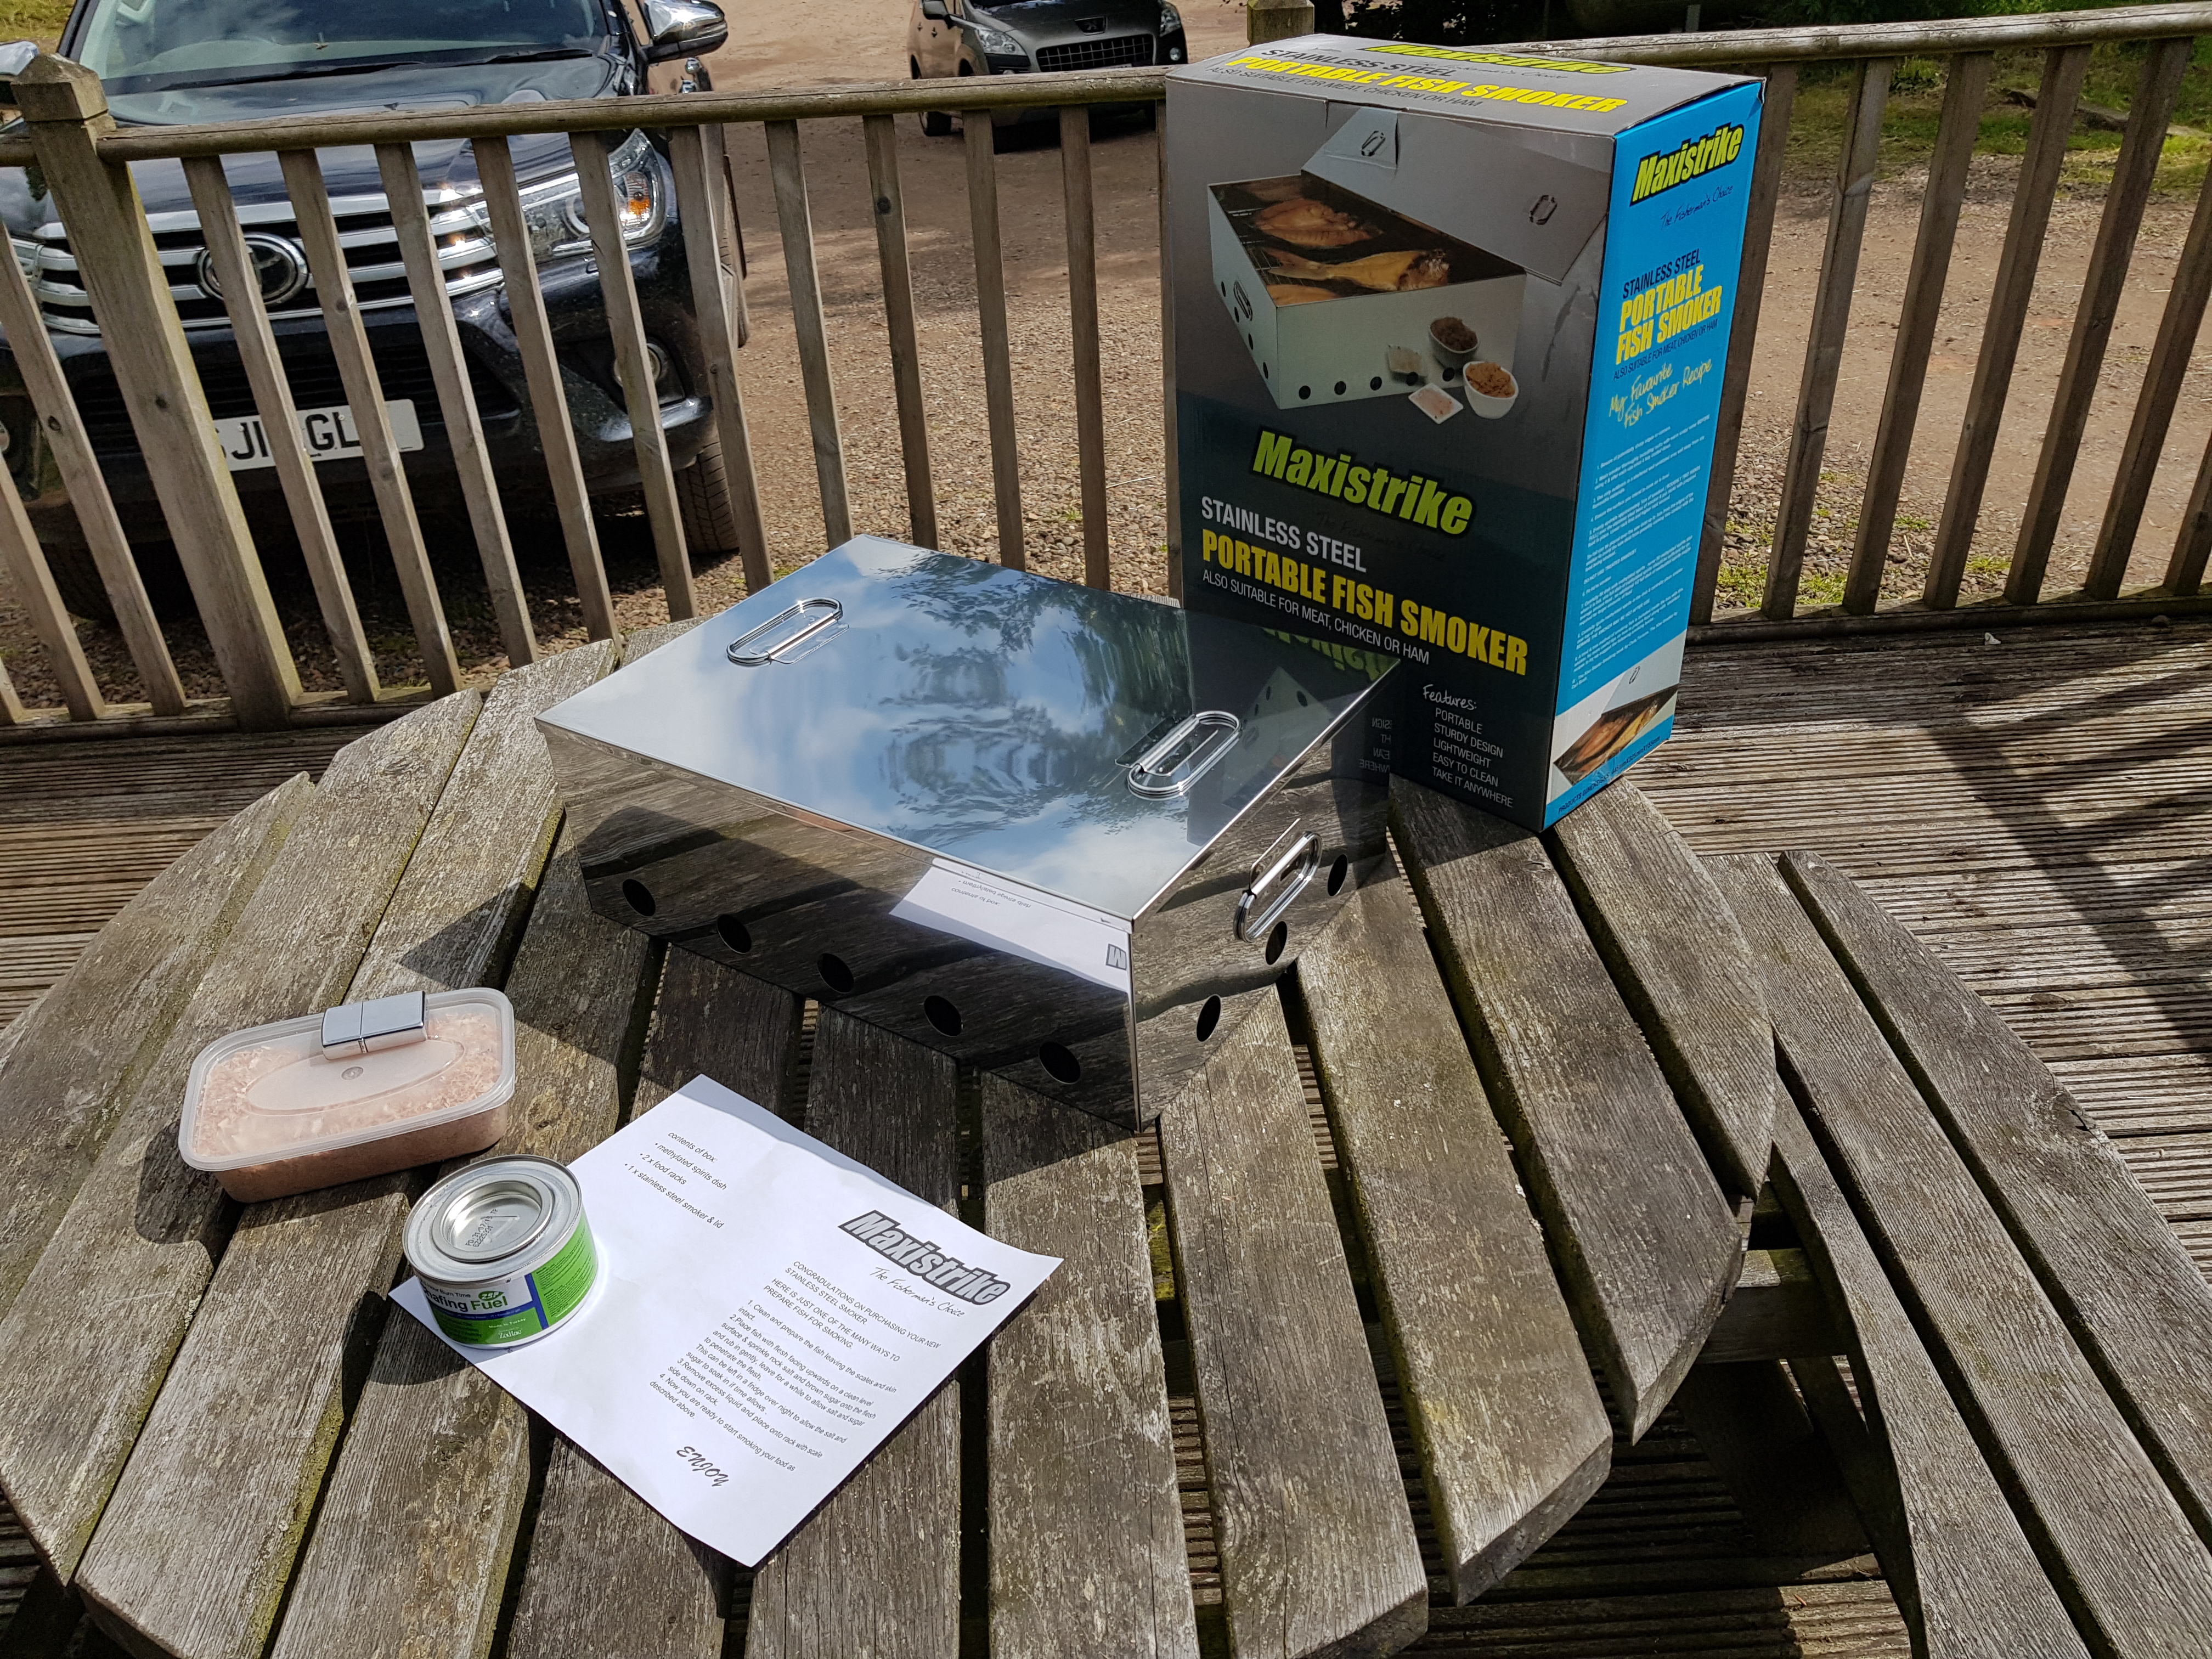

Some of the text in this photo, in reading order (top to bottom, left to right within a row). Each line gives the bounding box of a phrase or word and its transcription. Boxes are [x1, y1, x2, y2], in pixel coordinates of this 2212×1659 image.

[1262, 49, 1385, 70] STAINLESS
[1386, 61, 1458, 77] STEEL
[1359, 43, 1637, 74] Maxistrike
[1208, 67, 1244, 76] ALSO
[1239, 70, 1300, 84] SUITABLE
[1296, 78, 1325, 88] FOR
[1325, 81, 1361, 92] MEAT,
[1363, 87, 1427, 100] CHICKEN
[1446, 98, 1483, 107] HAM
[1226, 57, 1629, 112] PORTABLE FISH SMOKER
[1630, 122, 1744, 207] Maxistrike
[1660, 210, 1672, 230] The
[1623, 248, 1701, 299] STAINLESS STEEL
[1619, 264, 1704, 333] PORTABLE
[1616, 285, 1723, 365] FISH SMOKER
[1613, 366, 1627, 380] ALSO
[1628, 354, 1652, 373] SUITABLE
[1652, 348, 1663, 360] FOR
[1678, 330, 1698, 347] CHICKEN
[1699, 326, 1706, 337] OR
[1706, 318, 1718, 333] HAM
[1624, 402, 1643, 429] Fish
[1251, 426, 1476, 537] Maxistrike
[1201, 495, 1301, 549] STAINLESS
[1306, 531, 1367, 573] STEEL
[1203, 528, 1326, 604] PORTABLE
[1333, 574, 1393, 628] FISH
[1401, 599, 1528, 676] SMOKER
[1203, 569, 1228, 589] ALSO
[1231, 579, 1276, 608] SUITABLE
[1279, 597, 1299, 617] FOR
[1302, 605, 1332, 630] MEAT,
[1334, 618, 1381, 647] CHICKEN
[1384, 636, 1400, 654] OR
[1403, 642, 1430, 665] HAM
[1423, 684, 1477, 710] Features:
[1434, 723, 1504, 758] STURDY DESIGN
[1435, 707, 1483, 735] PORTABLE
[1432, 752, 1499, 787] EASY TO CLEAN
[1434, 737, 1492, 768] LIGHTWEIGHT
[1432, 766, 1514, 808] TAKE IT ANYWHERE
[668, 1133, 695, 1149] contents
[653, 1161, 670, 1172] food
[668, 1172, 686, 1184] racks
[657, 1146, 726, 1189] methylated spirits dish
[638, 1173, 666, 1192] stainless
[666, 1192, 684, 1203] steel
[682, 1203, 708, 1218] smoker
[838, 1210, 1011, 1305] Maxistrike
[470, 1295, 508, 1310] Fuel
[785, 1267, 820, 1293] STAINLESS
[818, 1290, 838, 1306] STEEL
[793, 1261, 941, 1348] CONGRADULATIONS ON PURCHASING YOUR NEW
[869, 1267, 965, 1317] The Fisherman's Choice
[738, 1306, 755, 1321] intact.
[763, 1285, 853, 1349] PREPARE FISH FOR SMOKING.
[771, 1278, 791, 1293] HERE
[796, 1296, 815, 1309] JUST
[813, 1307, 829, 1319] ONE
[838, 1323, 853, 1335] THE
[850, 1331, 872, 1346] MANY
[870, 1342, 890, 1357] WAYS
[889, 1353, 900, 1362] TO
[729, 1314, 751, 1331] 2.Place
[751, 1329, 762, 1339] fish
[761, 1337, 774, 1347] with
[773, 1345, 788, 1358] flesh
[787, 1355, 806, 1372] facing
[805, 1368, 831, 1386] upwards
[843, 1392, 859, 1402] clean
[753, 1304, 770, 1318] Clean
[769, 1317, 783, 1326] and
[780, 1324, 804, 1342] prepare
[803, 1340, 814, 1348] the
[813, 1346, 825, 1356] fish
[823, 1352, 846, 1370] leaving
[845, 1367, 855, 1375] the
[855, 1373, 874, 1385] scales
[650, 1381, 695, 1419] described above.
[676, 1446, 729, 1487] ENJOY
